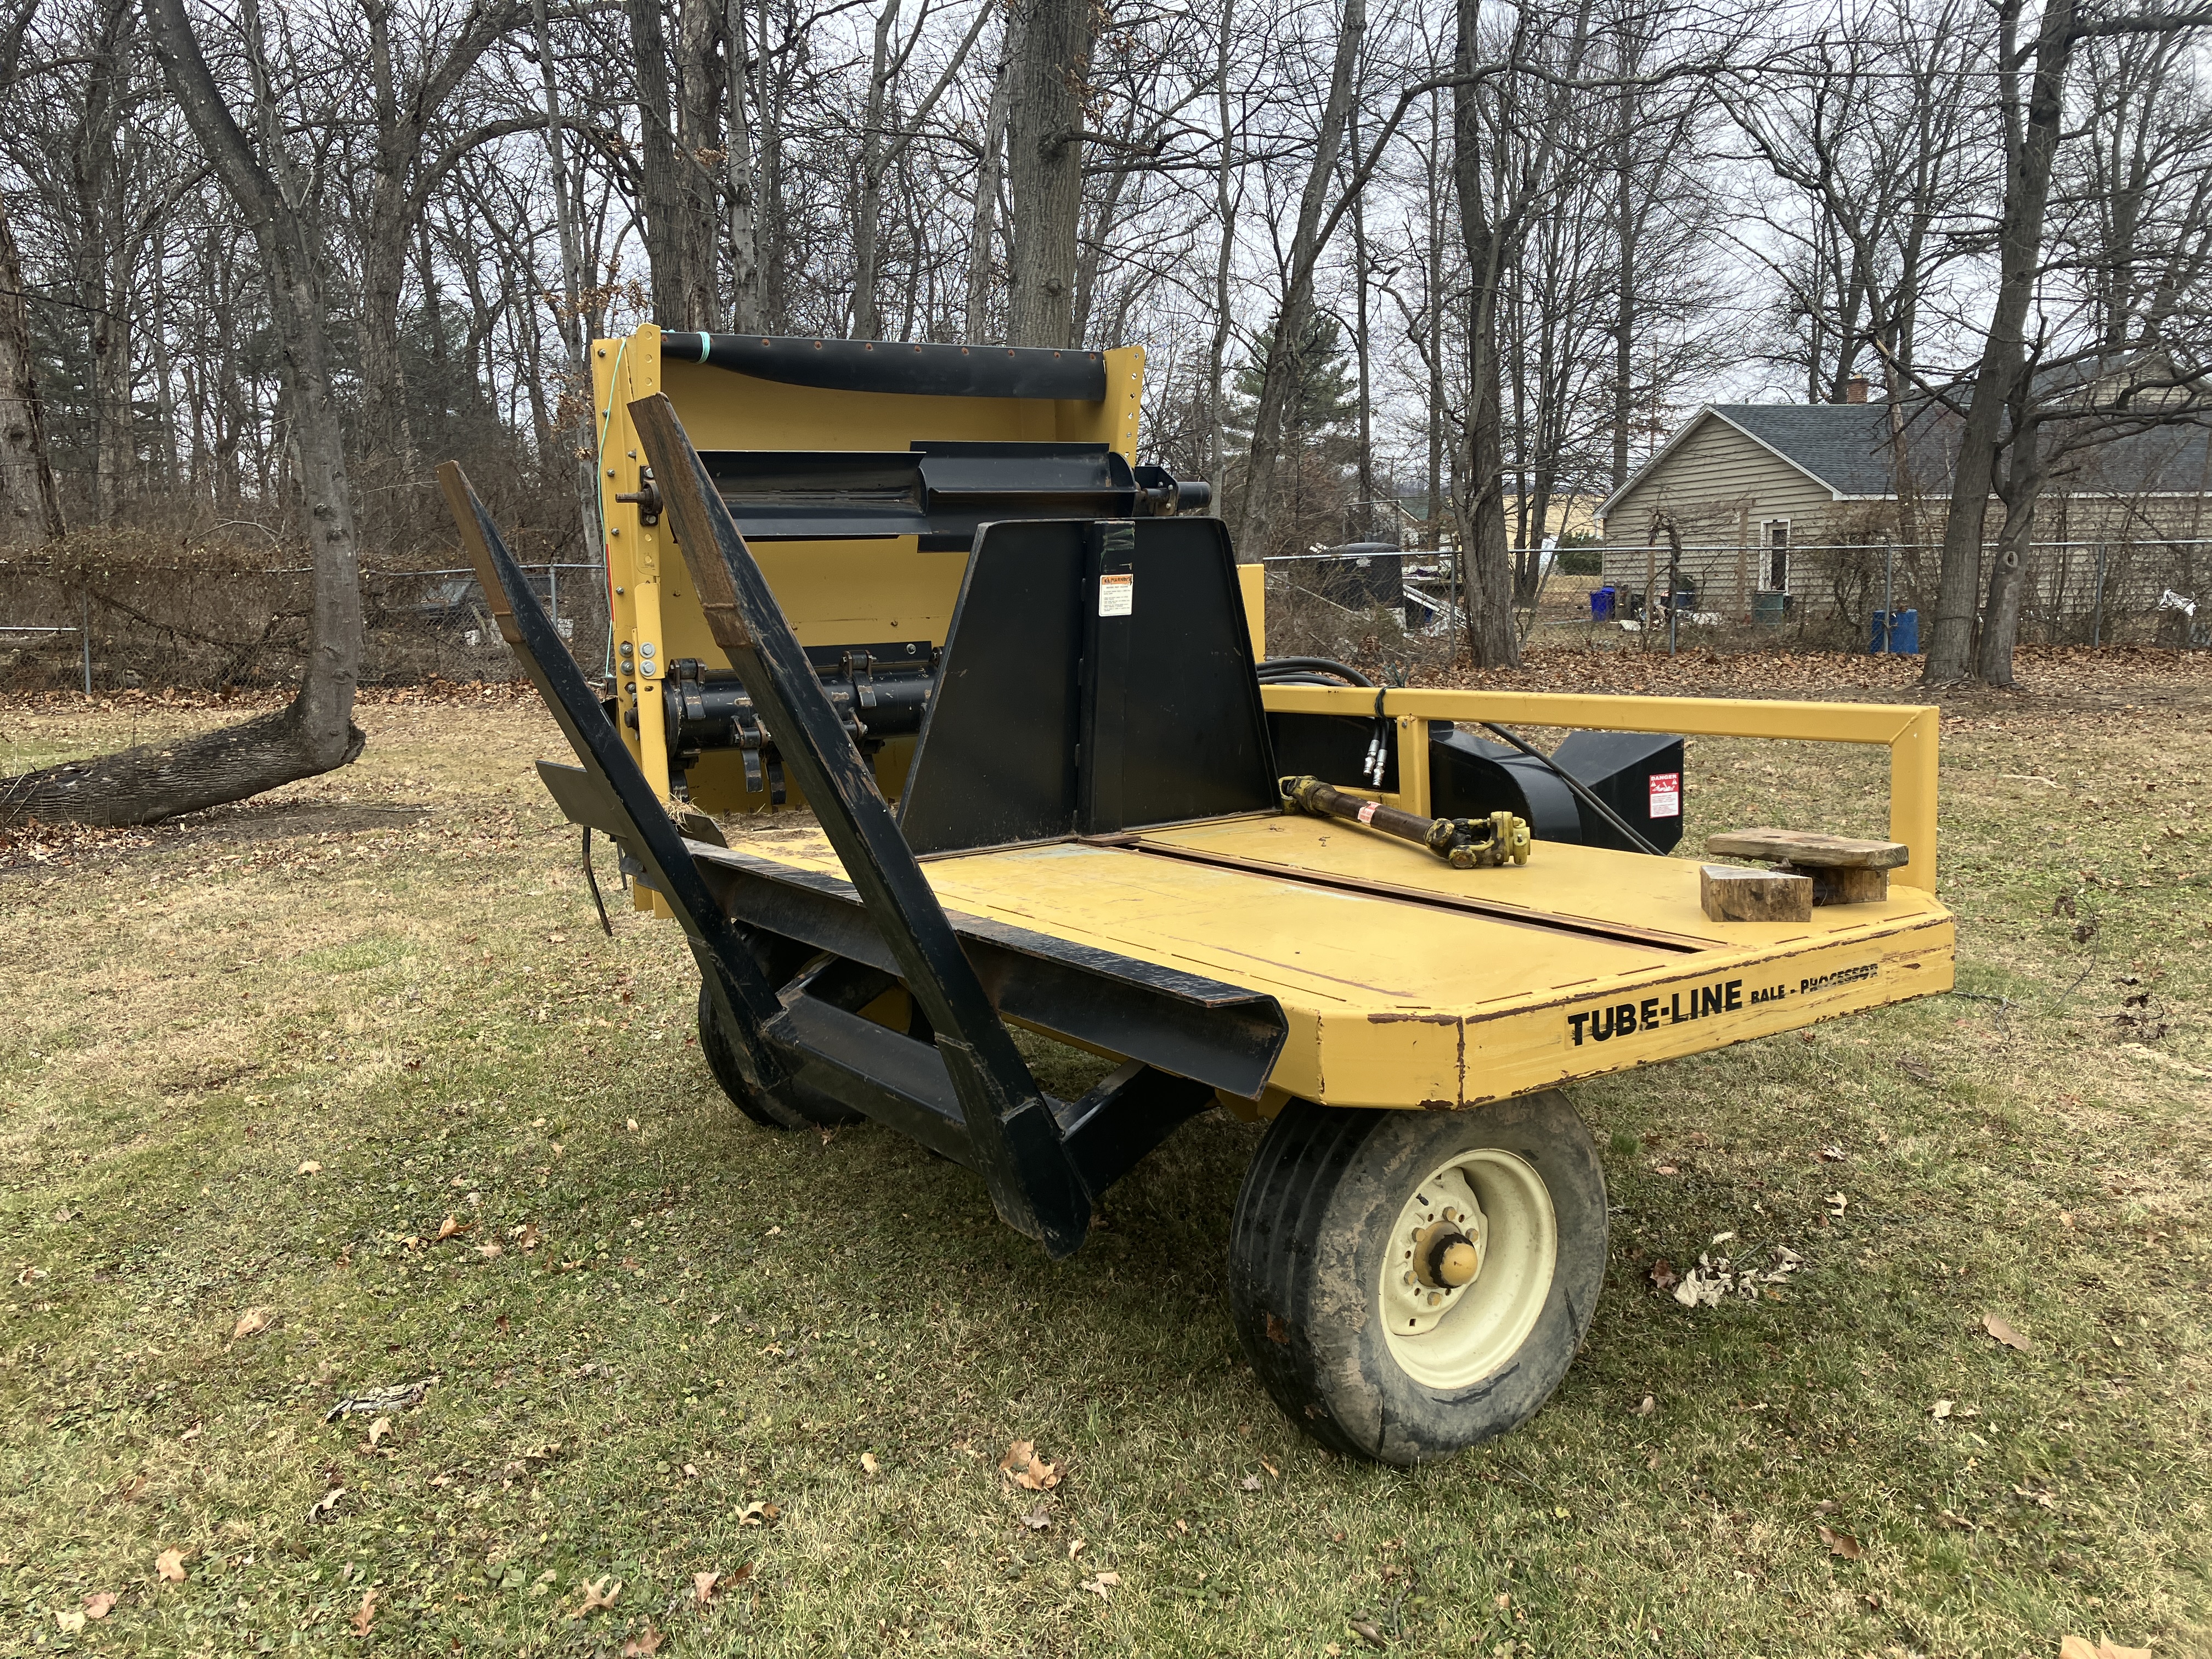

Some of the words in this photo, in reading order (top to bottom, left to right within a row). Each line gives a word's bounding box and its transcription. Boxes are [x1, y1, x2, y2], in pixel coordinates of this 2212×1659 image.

[1567, 979, 1742, 1046] TUBE-LINE
[1751, 984, 1786, 1005] BALE
[1801, 963, 1878, 995] PROCESSOR
